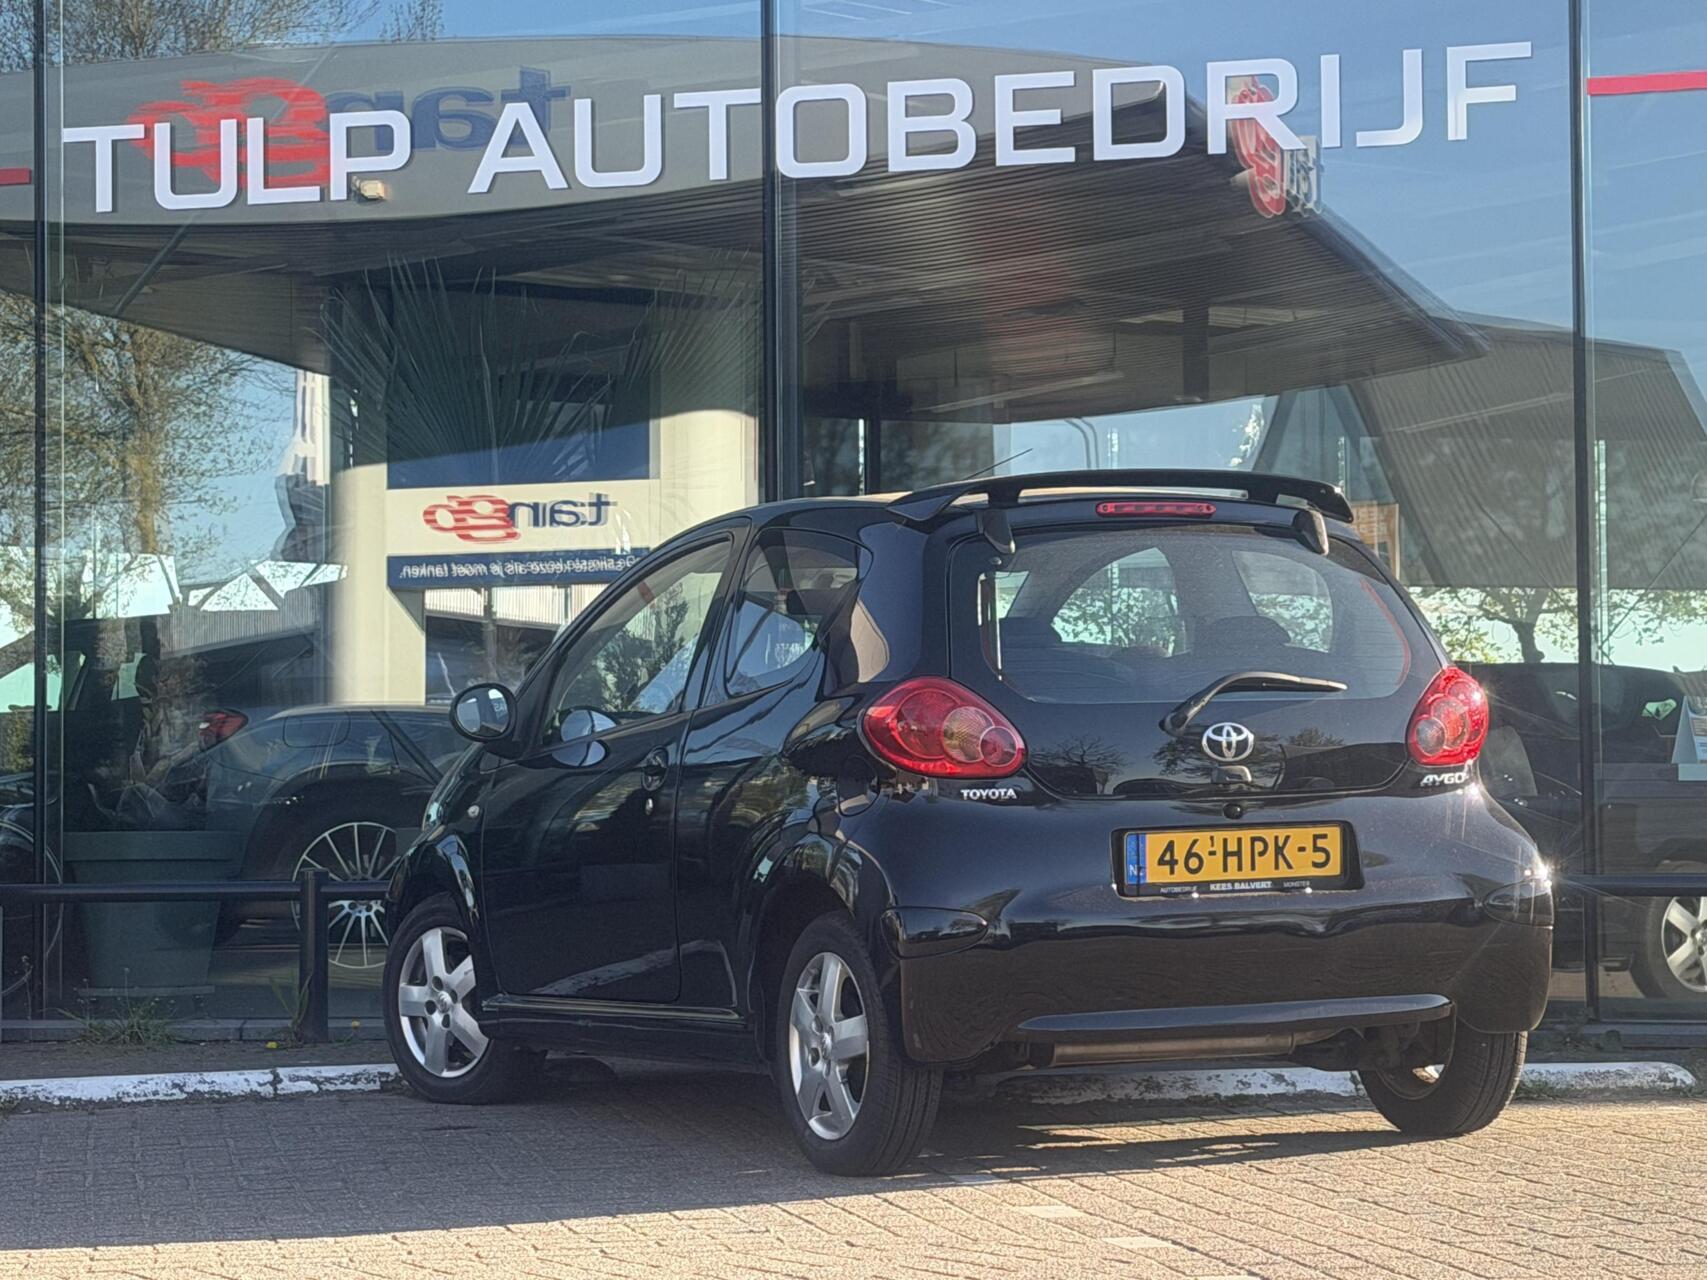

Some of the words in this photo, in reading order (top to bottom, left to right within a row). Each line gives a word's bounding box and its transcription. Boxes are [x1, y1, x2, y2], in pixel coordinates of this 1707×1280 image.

[62, 110, 411, 213] TULP
[467, 41, 1532, 197] AUTOBEDRIJF
[1420, 772, 1468, 787] AYGO
[960, 788, 1017, 800] TOYOTA
[1157, 833, 1332, 876] 46-HPK-5
[1209, 882, 1233, 891] KEES
[1234, 880, 1273, 890] BALVERT
